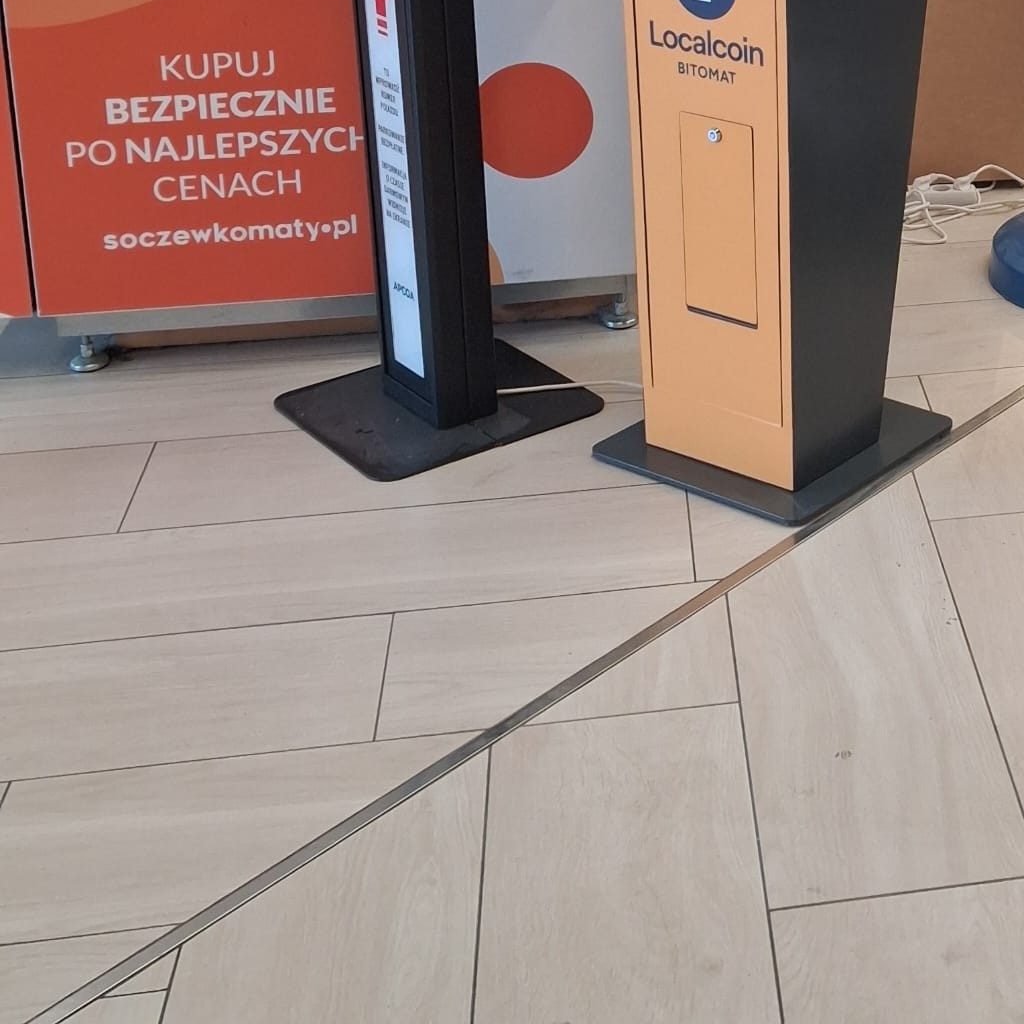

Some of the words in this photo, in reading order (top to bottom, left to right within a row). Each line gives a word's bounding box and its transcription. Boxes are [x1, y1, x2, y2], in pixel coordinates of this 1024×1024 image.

[649, 20, 764, 67] Localcoin
[160, 50, 276, 81] KUPUJ
[678, 61, 737, 85] BITOMAT
[105, 87, 337, 126] BEZPIECZNIE
[65, 140, 117, 168] PO
[153, 169, 303, 203] CENACH
